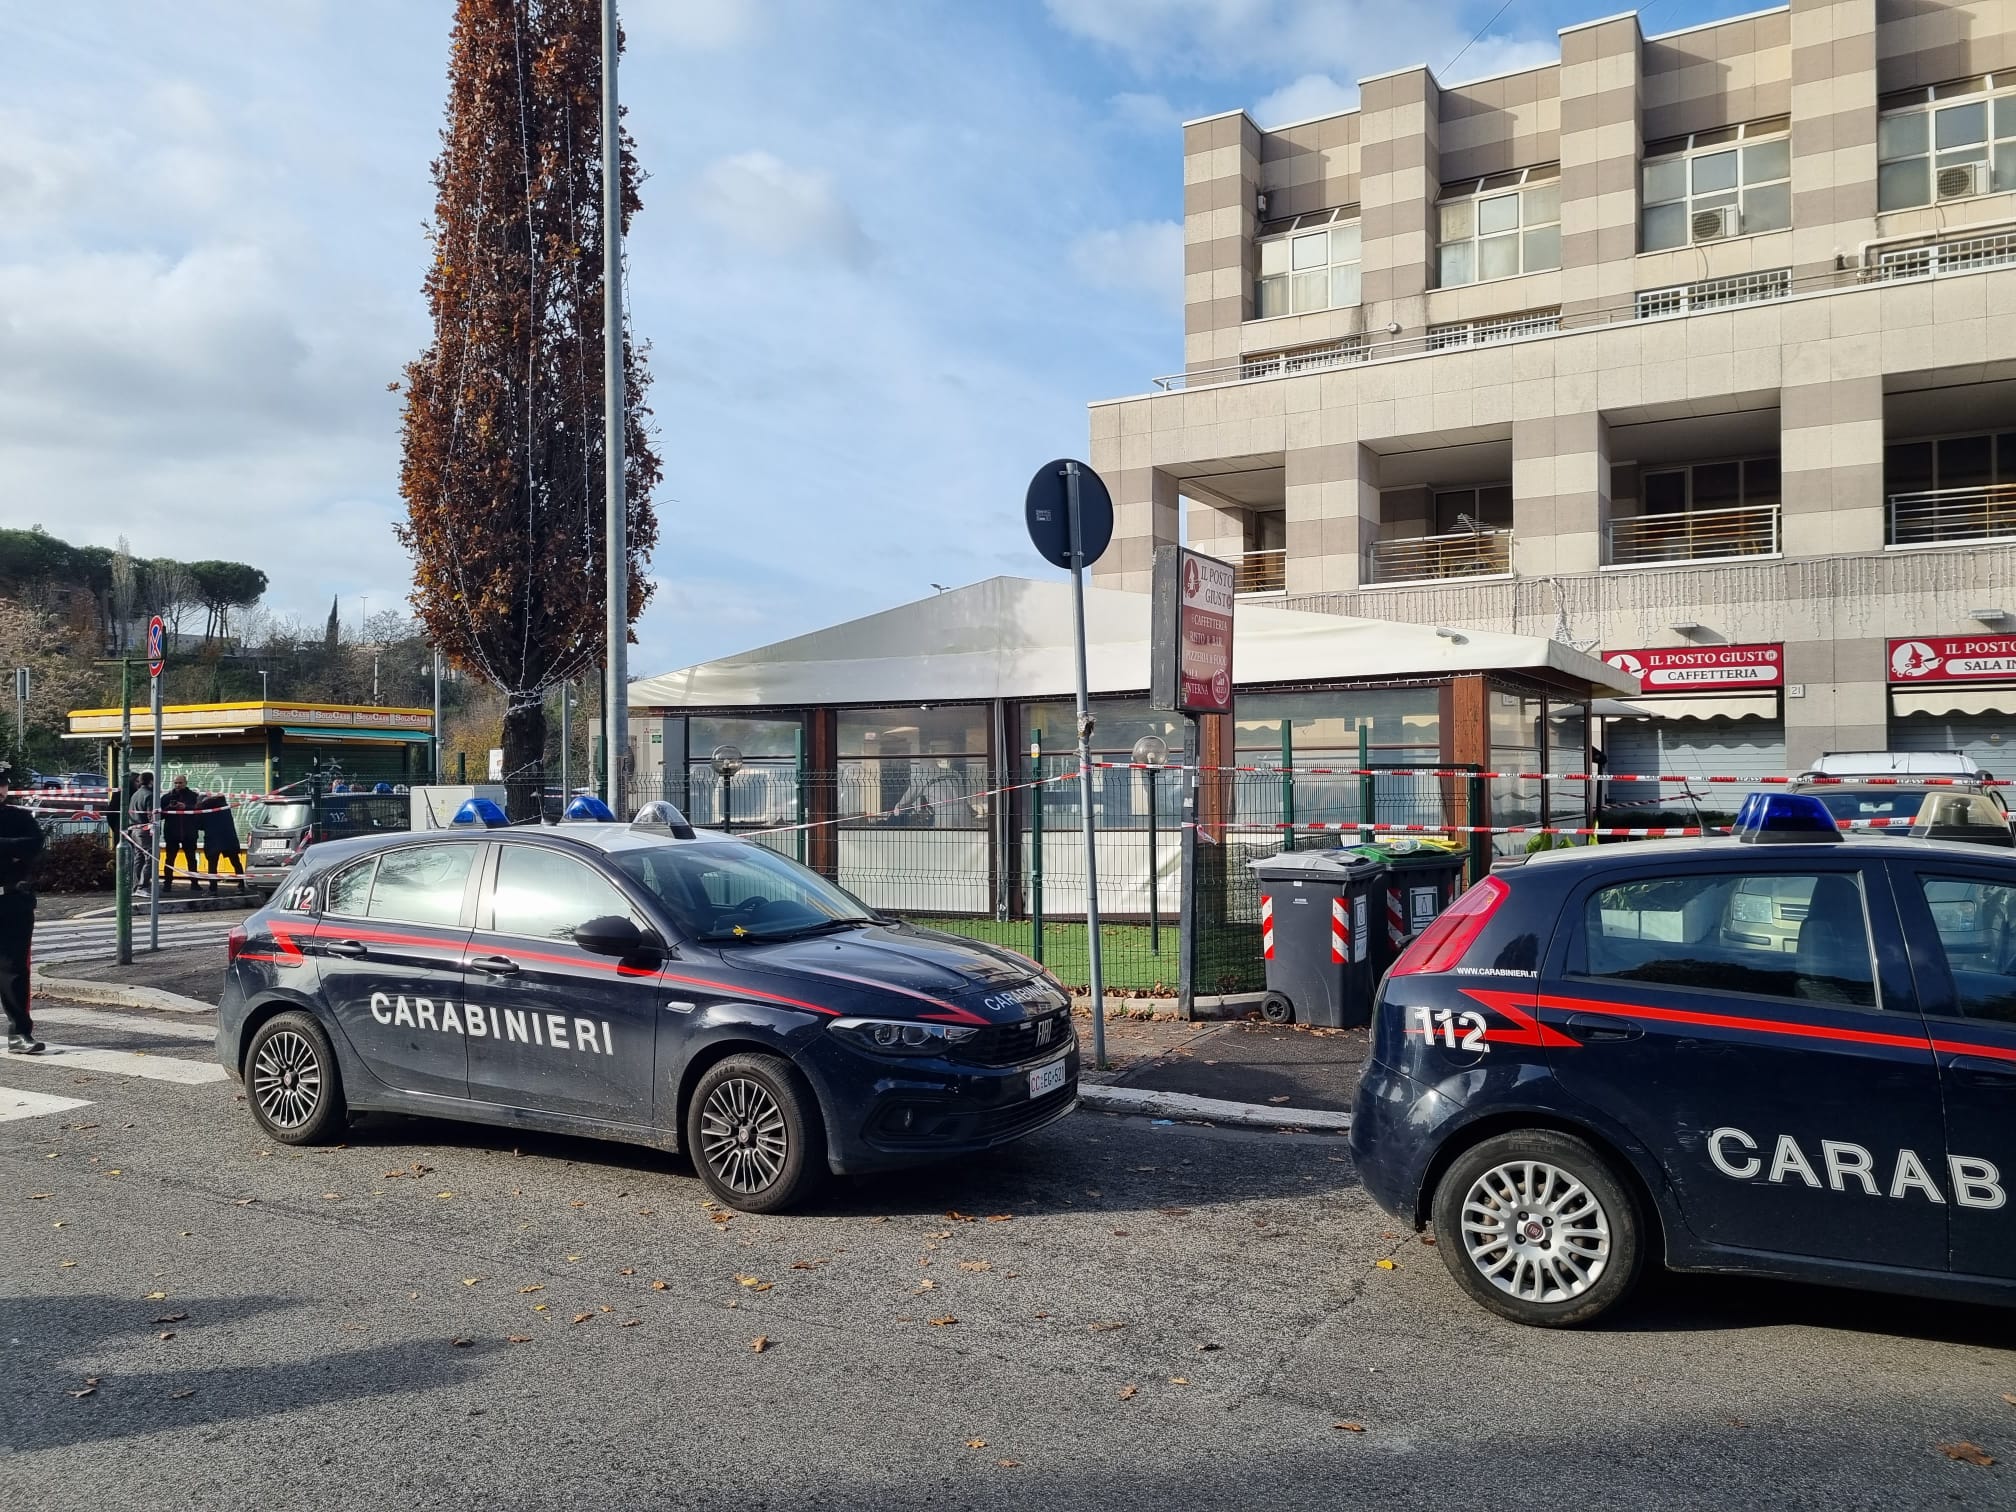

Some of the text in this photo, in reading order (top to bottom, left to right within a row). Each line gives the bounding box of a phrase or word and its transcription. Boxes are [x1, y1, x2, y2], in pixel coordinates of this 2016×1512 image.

[1200, 565, 1233, 589] IL POSTO
[1205, 588, 1233, 610] GIUSTO
[1194, 614, 1228, 633] CAFFETTERIA
[1649, 649, 1778, 666] IL POSTO GIUSTO
[1944, 643, 1962, 655] IL
[1667, 667, 1759, 682] CAFFETTERIA
[1964, 660, 2003, 672] SALA
[1791, 686, 1801, 695] 21
[285, 886, 315, 910] 112
[1456, 967, 1538, 979] WWW.CARABINIERI.IT
[370, 991, 614, 1056] CARABINIERI
[1035, 1018, 1054, 1048] FIAT
[1414, 1006, 1490, 1053] 112
[1030, 1075, 1040, 1093] CC
[1707, 1126, 2007, 1210] CARAB
